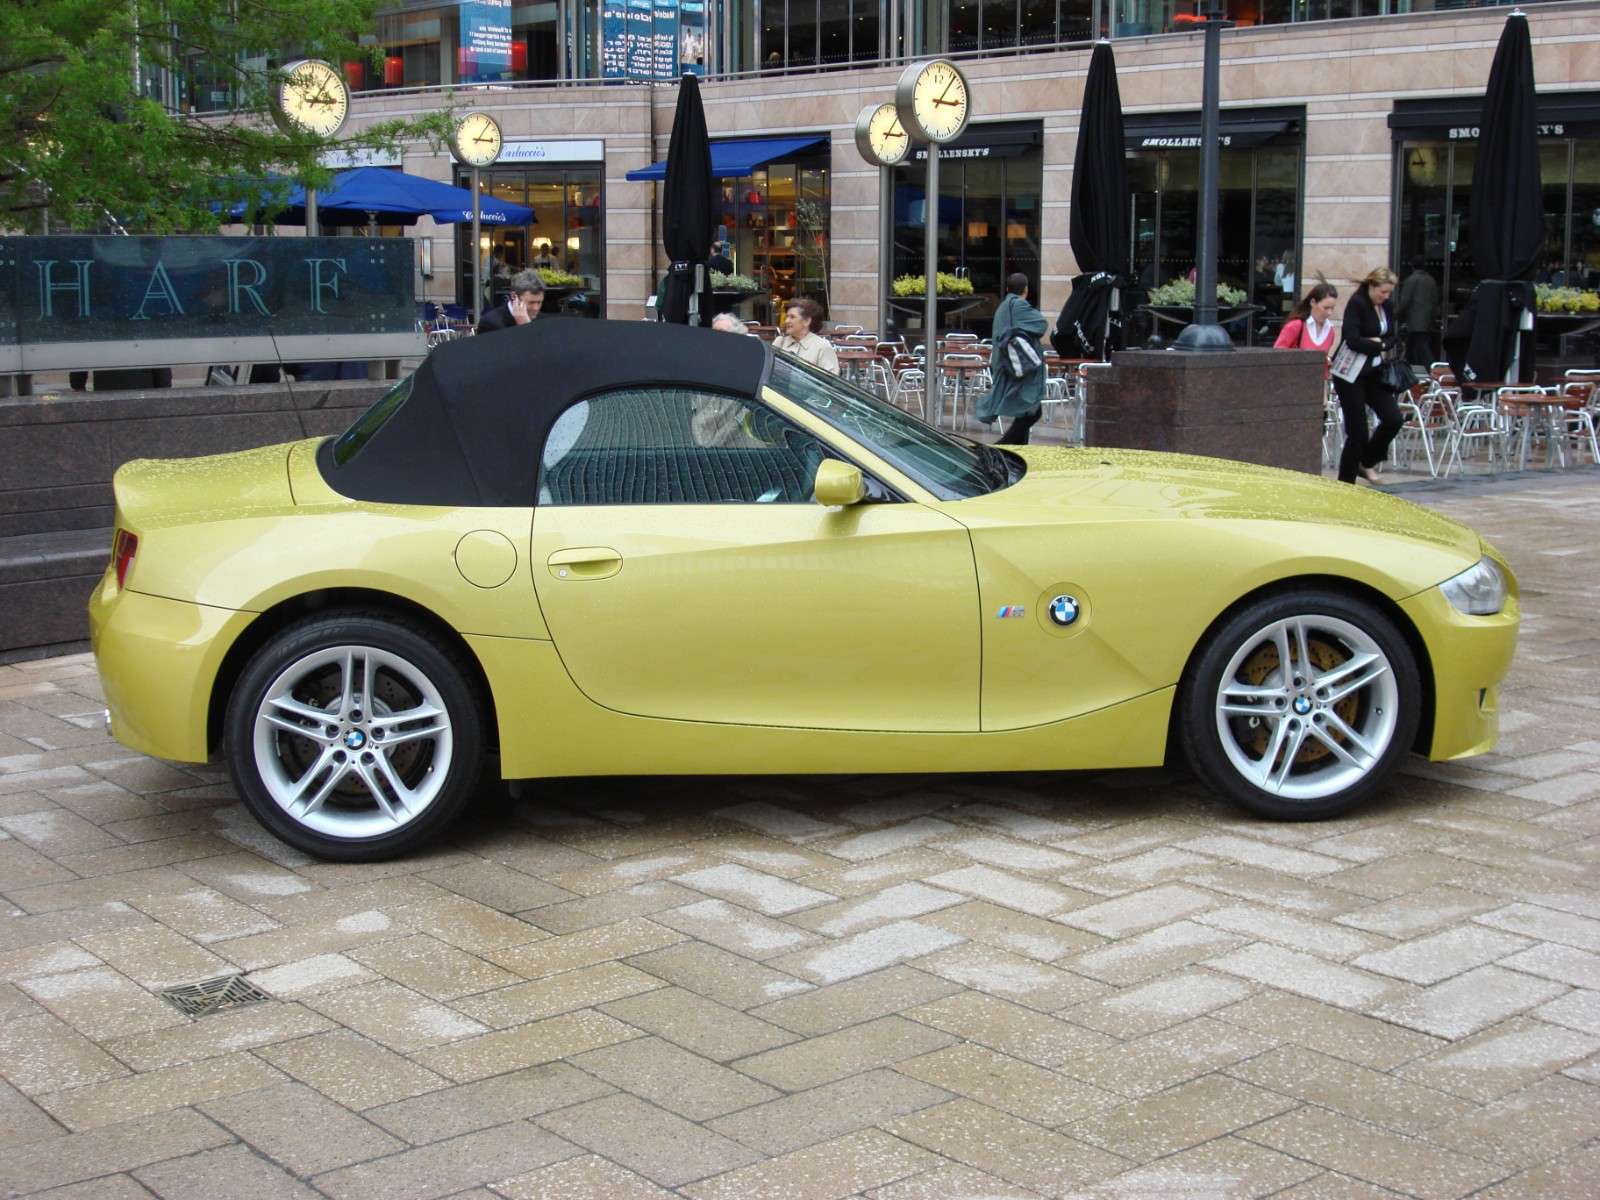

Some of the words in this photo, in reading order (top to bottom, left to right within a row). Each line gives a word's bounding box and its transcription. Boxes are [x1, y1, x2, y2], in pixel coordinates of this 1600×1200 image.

[934, 75, 944, 85] 12
[916, 147, 990, 159] SMLLENSKY'S
[462, 210, 507, 222] Caluccio's
